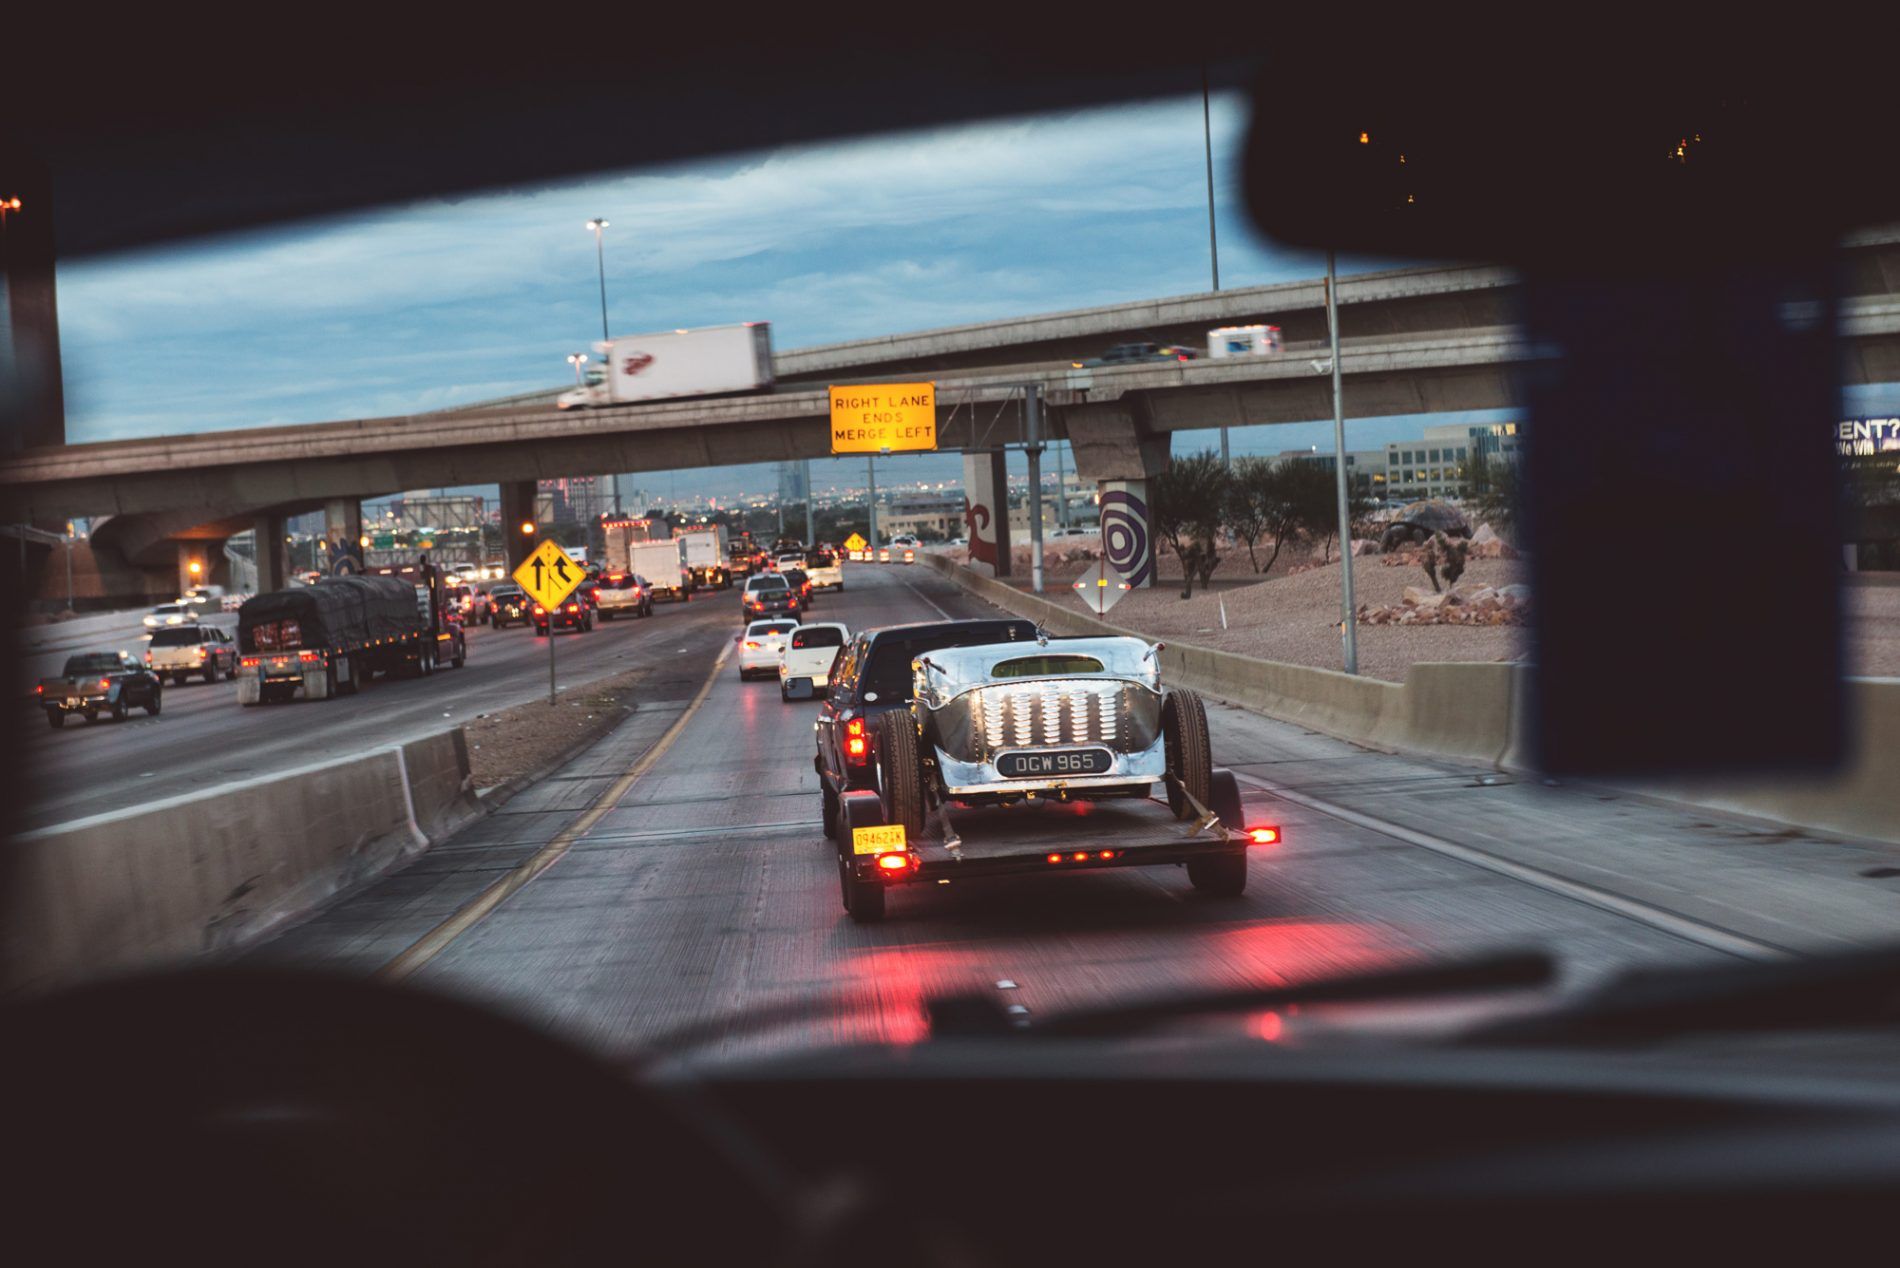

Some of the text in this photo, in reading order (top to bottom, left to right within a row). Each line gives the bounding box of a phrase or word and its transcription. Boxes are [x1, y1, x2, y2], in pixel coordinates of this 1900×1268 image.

[835, 395, 930, 409] RIGHT LANE
[863, 411, 904, 424] ENDS
[835, 426, 932, 440] MERGE LEFT
[1834, 418, 1900, 440] ENT?
[1057, 754, 1094, 770] 965
